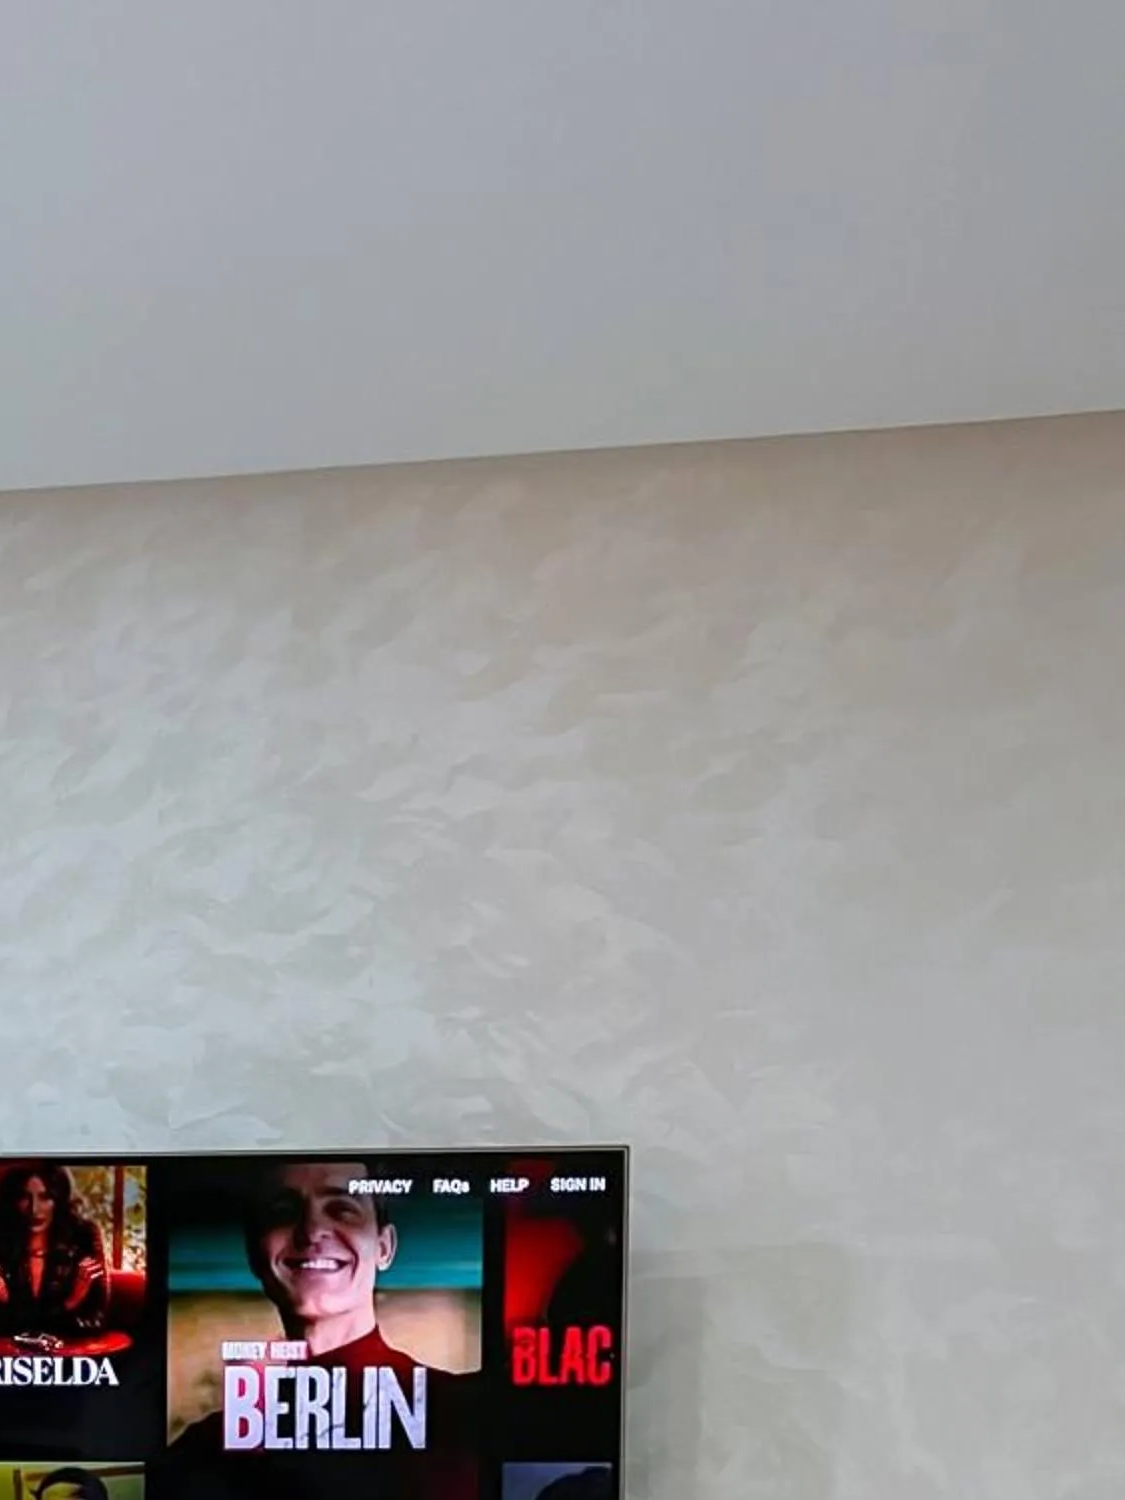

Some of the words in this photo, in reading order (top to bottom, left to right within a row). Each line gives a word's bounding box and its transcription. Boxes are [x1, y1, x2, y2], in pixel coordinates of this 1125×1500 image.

[348, 1179, 413, 1194] PRIVACY
[432, 1179, 470, 1194] FAQs
[490, 1178, 530, 1193] HELP
[550, 1177, 586, 1192] SIGN
[589, 1177, 606, 1191] IN
[513, 1324, 611, 1385] BLAC
[224, 1366, 426, 1450] BERLIN
